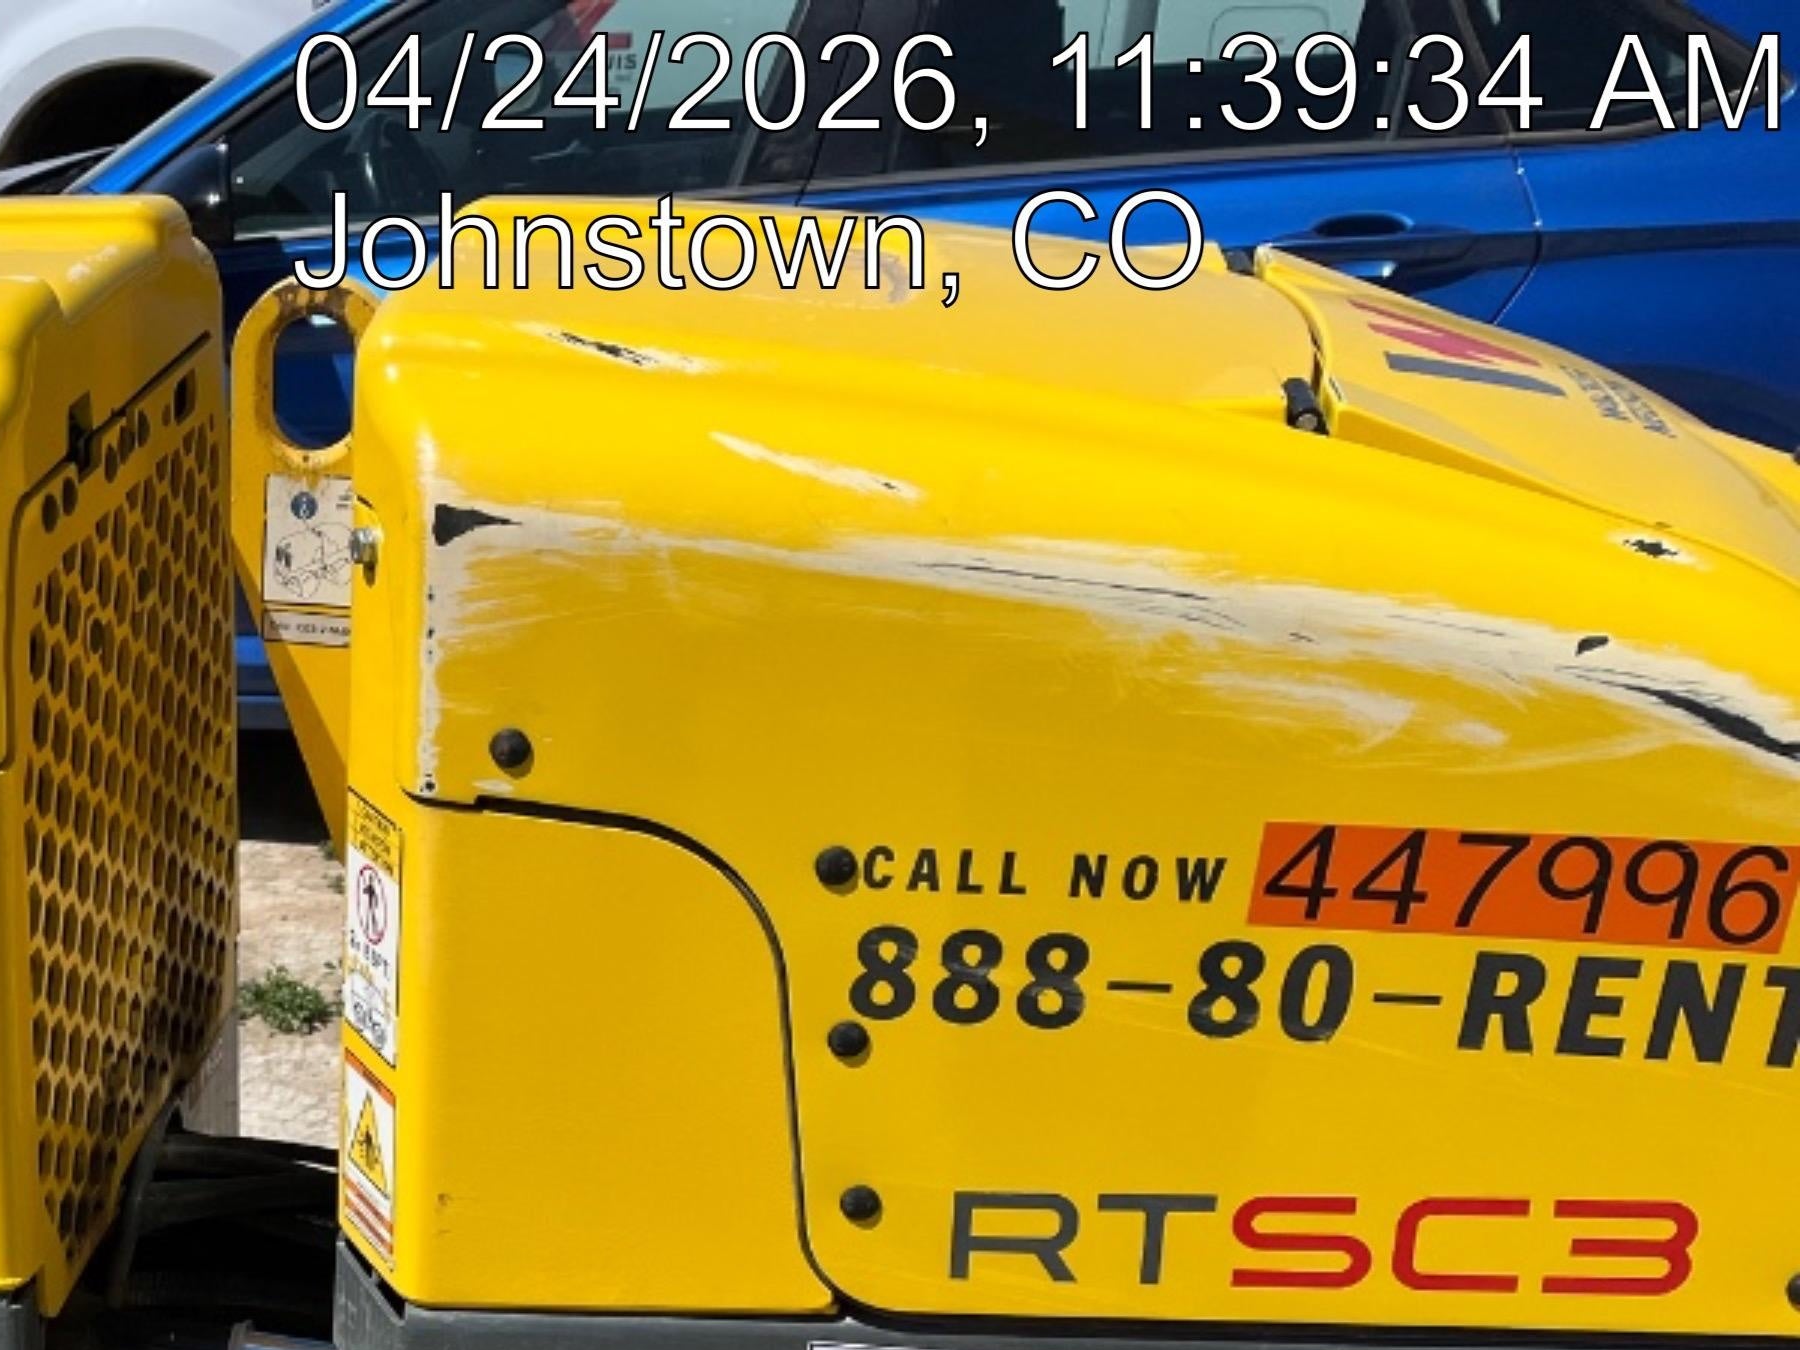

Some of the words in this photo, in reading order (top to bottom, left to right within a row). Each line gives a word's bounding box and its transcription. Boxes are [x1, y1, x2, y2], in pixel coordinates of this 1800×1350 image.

[863, 845, 1028, 895] CALL
[1067, 853, 1228, 903] NOW
[1263, 824, 1790, 946] 447996
[848, 924, 1800, 1069] 888-80-RENT
[947, 1190, 1701, 1298] RTSC3
